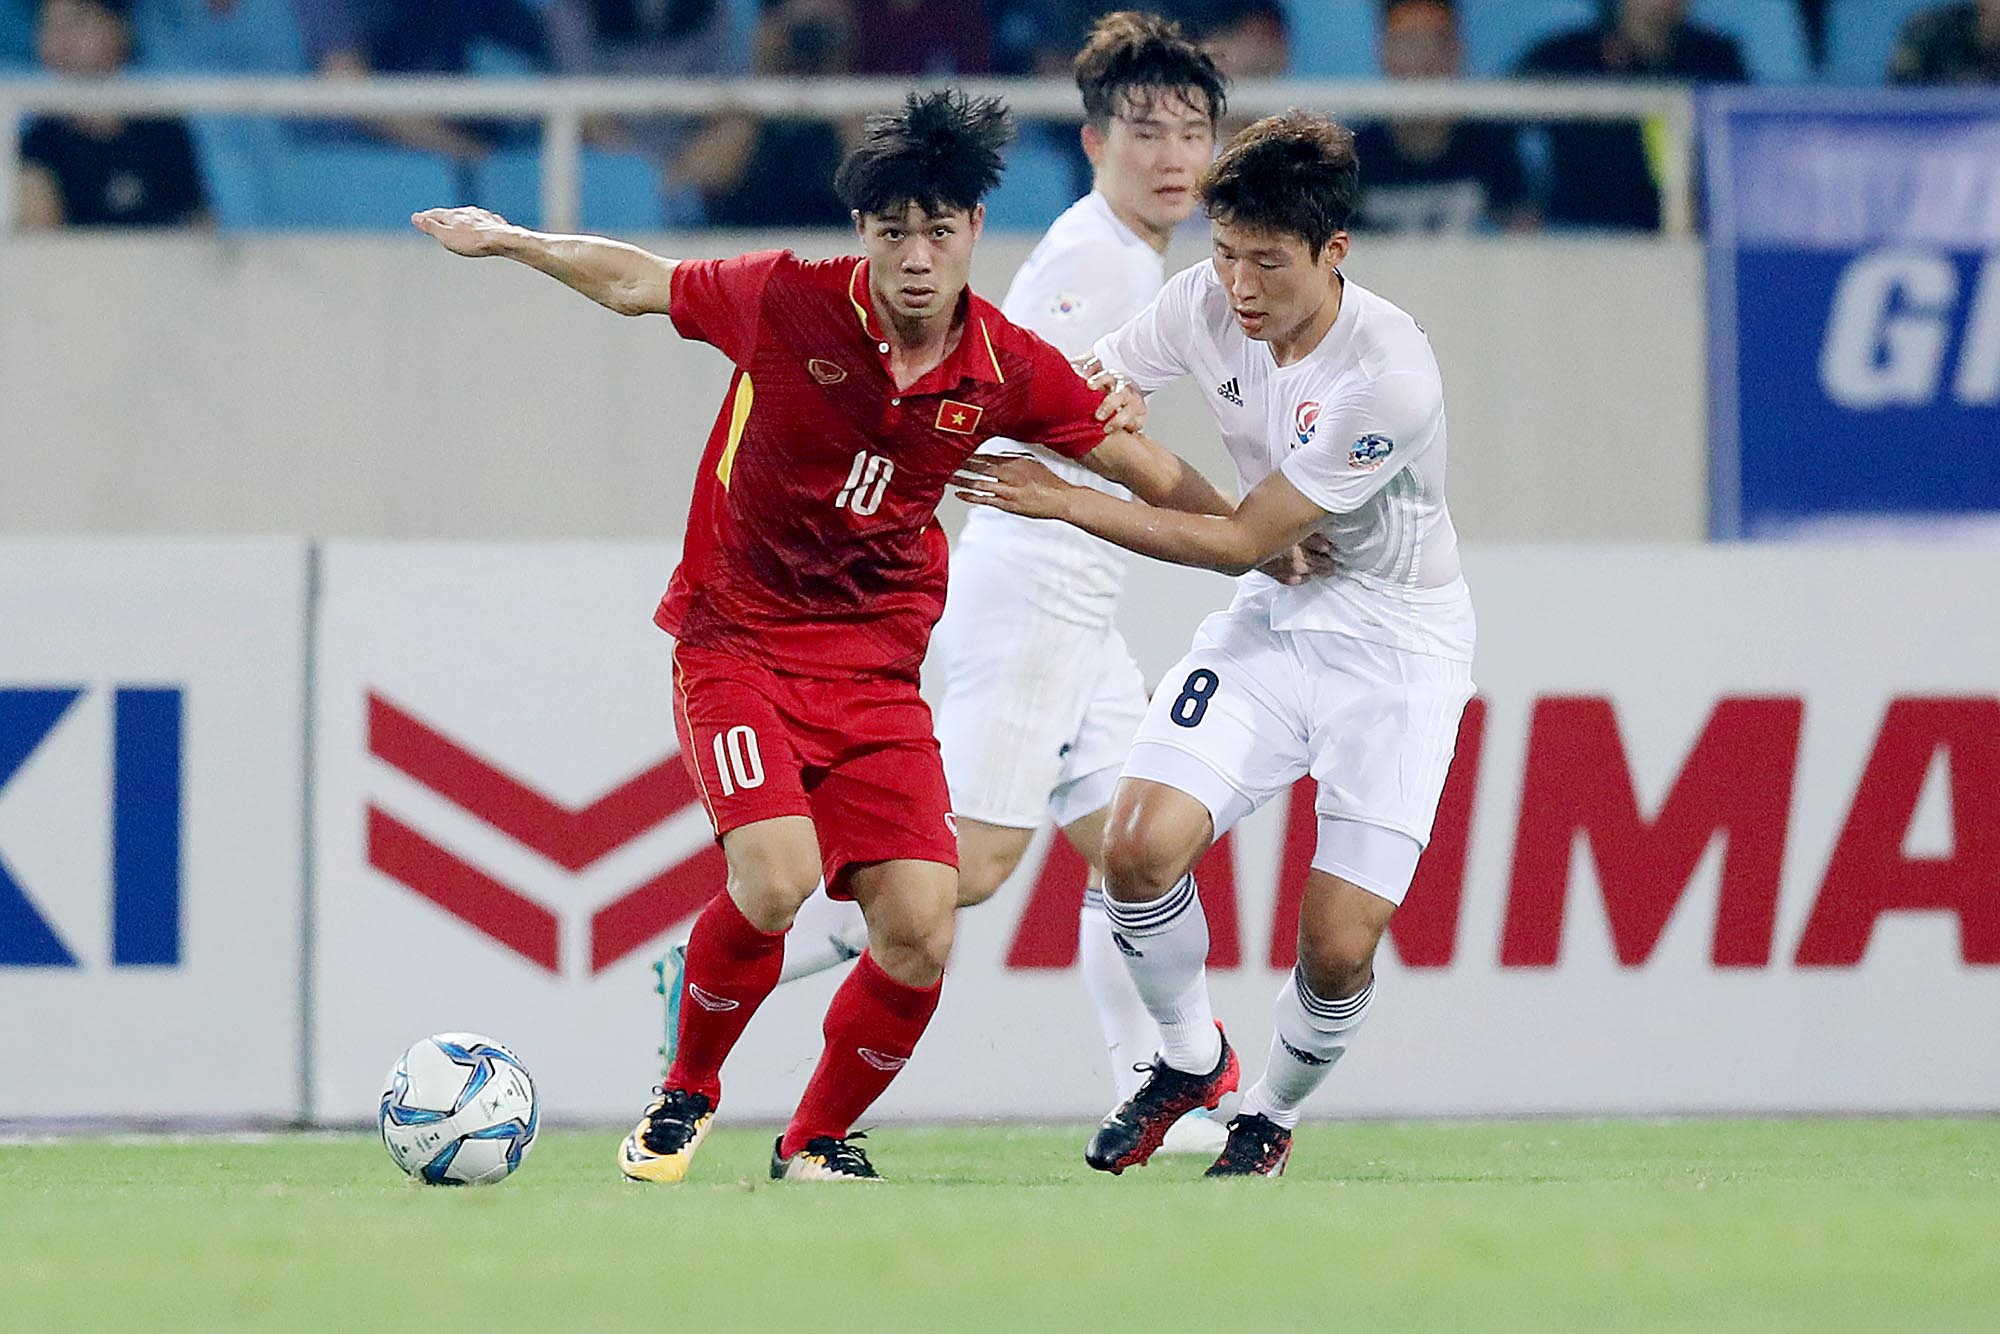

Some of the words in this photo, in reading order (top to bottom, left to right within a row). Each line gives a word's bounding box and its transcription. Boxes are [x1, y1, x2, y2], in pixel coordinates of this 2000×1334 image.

[835, 450, 895, 516] 10
[1170, 668, 1219, 728] 8
[713, 725, 766, 797] 10
